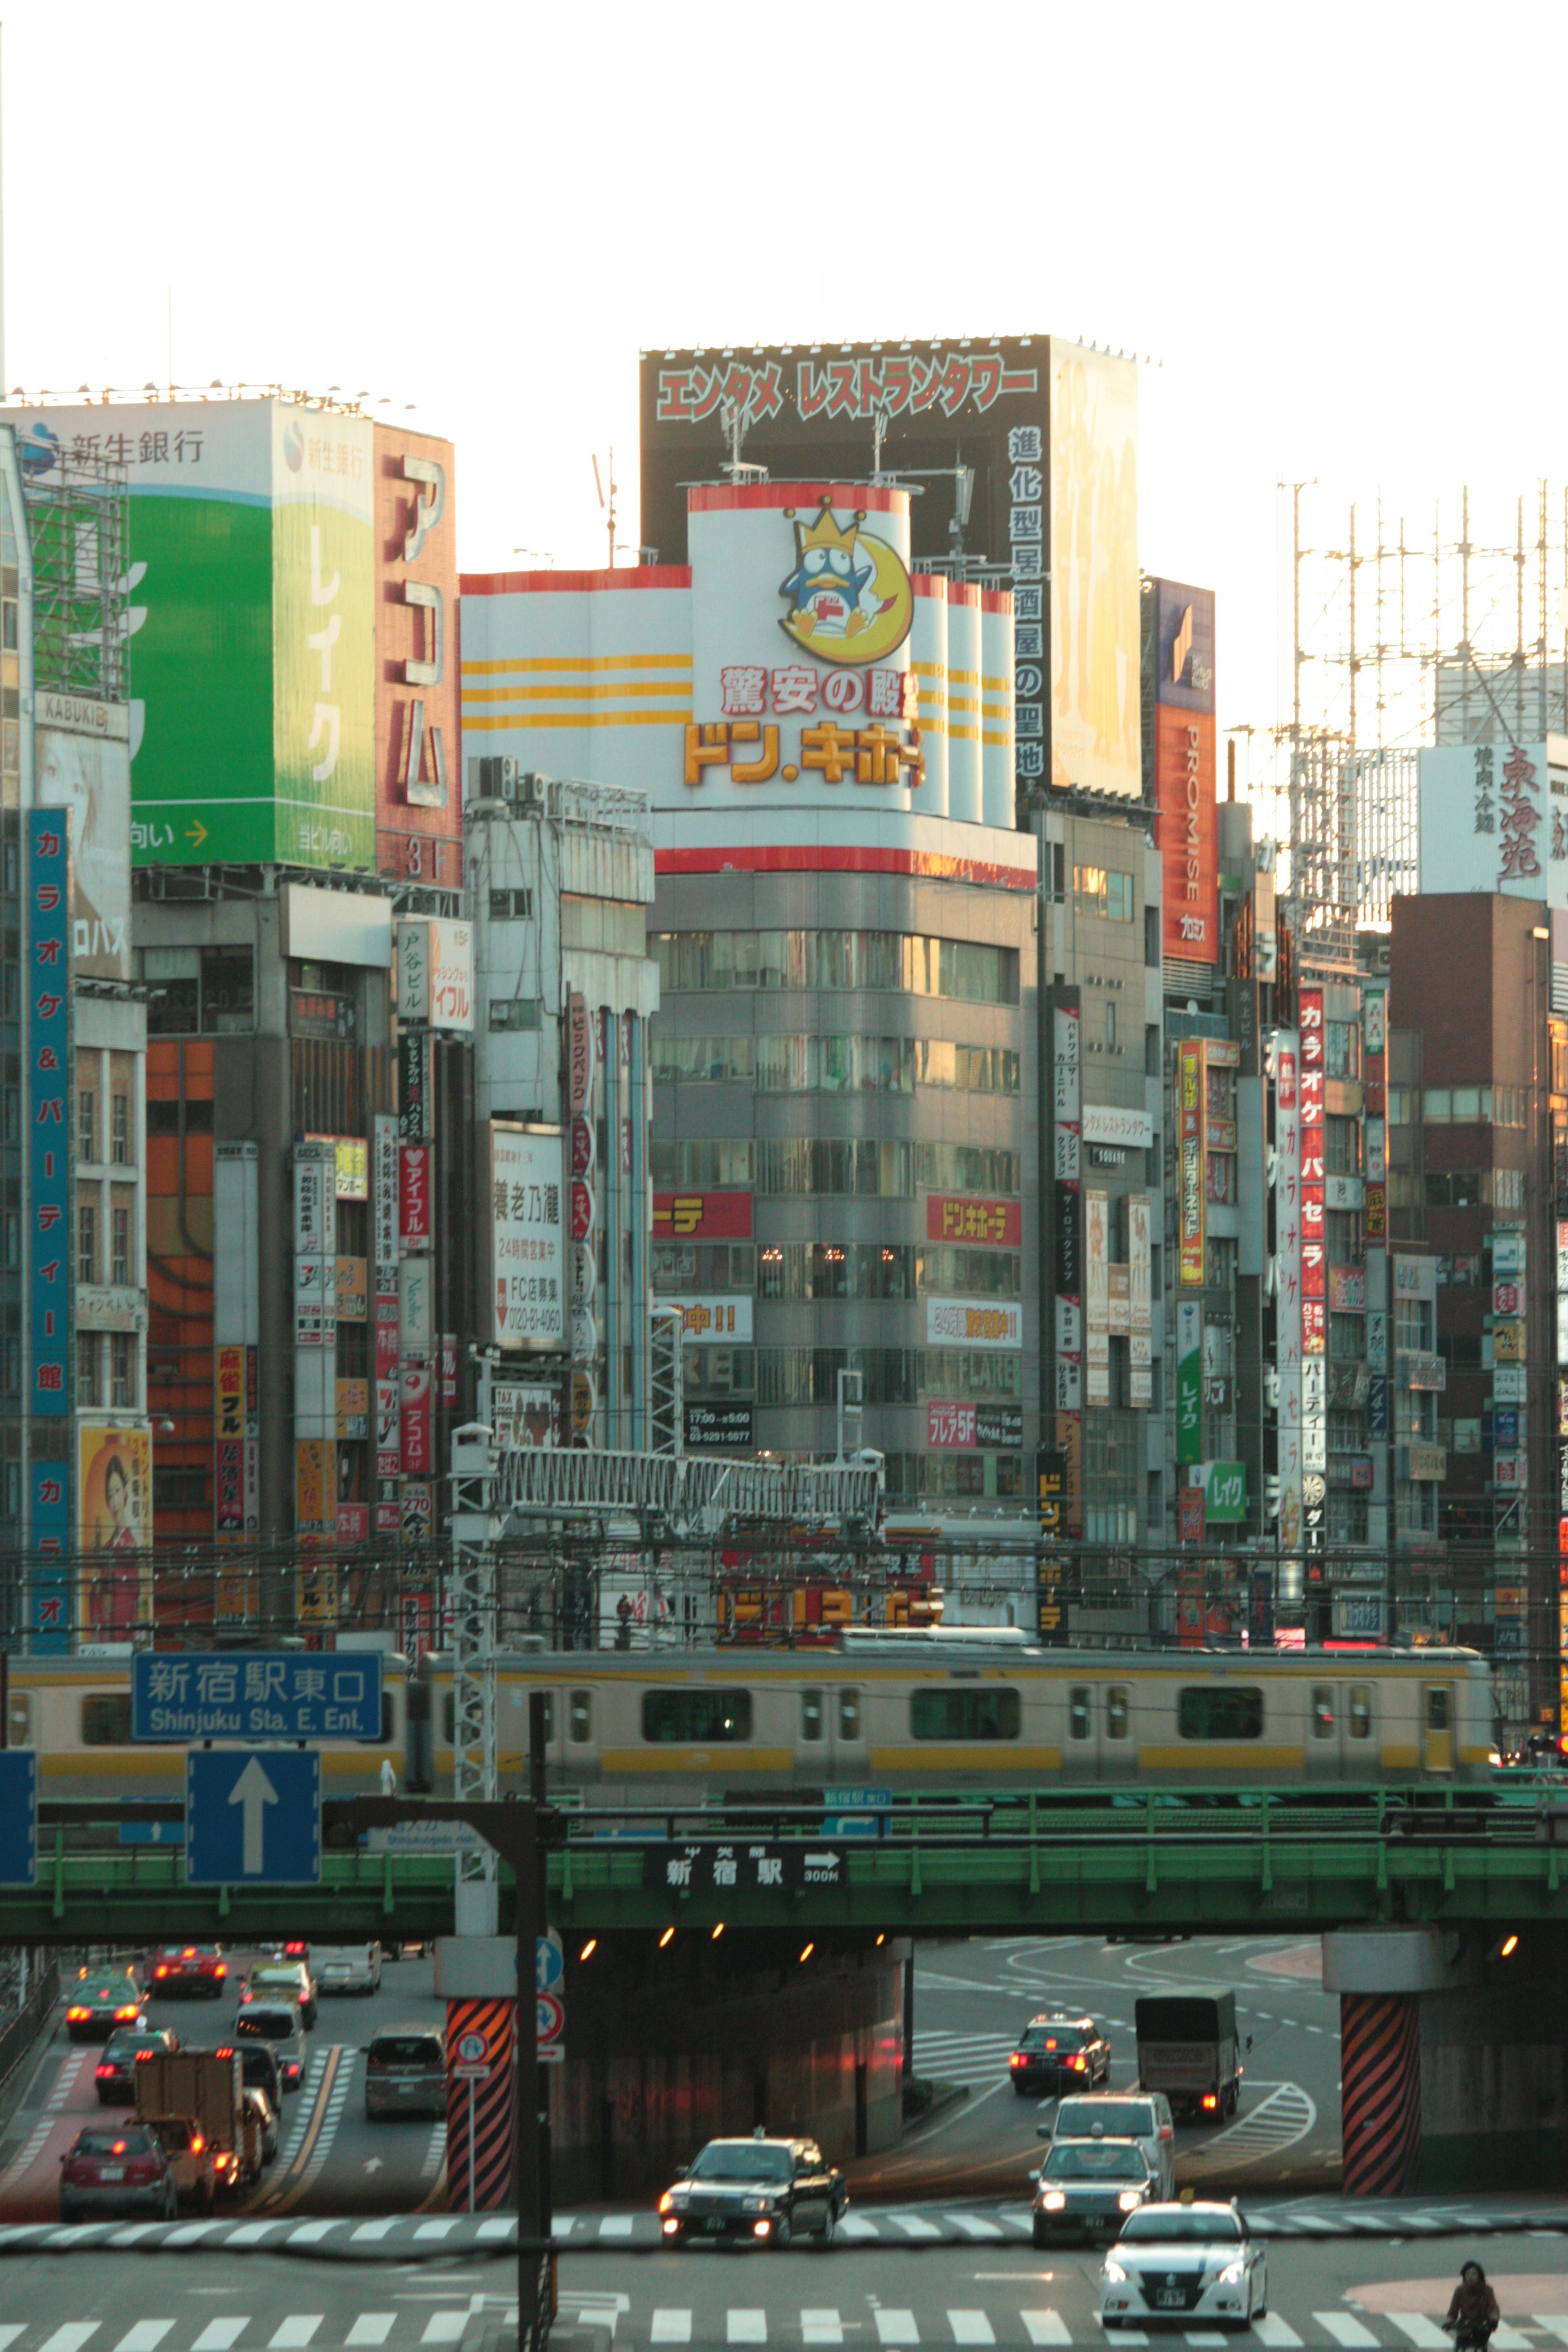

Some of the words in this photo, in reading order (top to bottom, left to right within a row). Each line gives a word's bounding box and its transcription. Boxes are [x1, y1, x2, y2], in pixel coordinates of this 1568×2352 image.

[657, 362, 783, 423] エンタメ
[797, 353, 1038, 421] レストランタワー
[70, 429, 203, 465] 新生銀行
[307, 439, 363, 479] 新生銀行
[1007, 425, 1045, 777] 進化型居酒屋の聖地
[401, 454, 448, 808] アコム
[307, 525, 341, 781] レイク
[1187, 725, 1200, 902] PROMISE
[1498, 745, 1543, 879] 東海苑
[299, 822, 353, 855] 当ビル向い
[408, 837, 448, 880] 3F
[1180, 913, 1206, 942] プロミス
[433, 986, 469, 1019] イフル
[1301, 1005, 1323, 1123] カラオケ
[1098, 1150, 1126, 1165] SQUARE
[407, 1167, 423, 1233] アイフル
[493, 1178, 559, 1225] 養老乃瀧
[1301, 1156, 1323, 1267] パセラ
[499, 1236, 556, 1262] 24時間営業中
[511, 1276, 558, 1303] FC店募集
[1314, 1304, 1323, 1328] 名物
[497, 1390, 513, 1404] TAX
[1183, 1382, 1197, 1429] レイク
[1306, 1363, 1322, 1447] パーティー
[1371, 1379, 1383, 1425] 747
[408, 1409, 422, 1457] アコム
[930, 1416, 958, 1443] フレア
[958, 1409, 974, 1443] 5F
[403, 1498, 430, 1511] 270
[1213, 1475, 1243, 1508] レイク
[148, 1660, 364, 1704] 新宿駅東口
[150, 1707, 241, 1735] Shinjuku
[249, 1708, 287, 1731] Sta.
[297, 1708, 318, 1730] E.
[325, 1708, 363, 1731] Ent.
[825, 1789, 887, 1805] 新宿駅東口
[666, 1858, 783, 1886] 新宿駅
[804, 1870, 839, 1882] 300M
